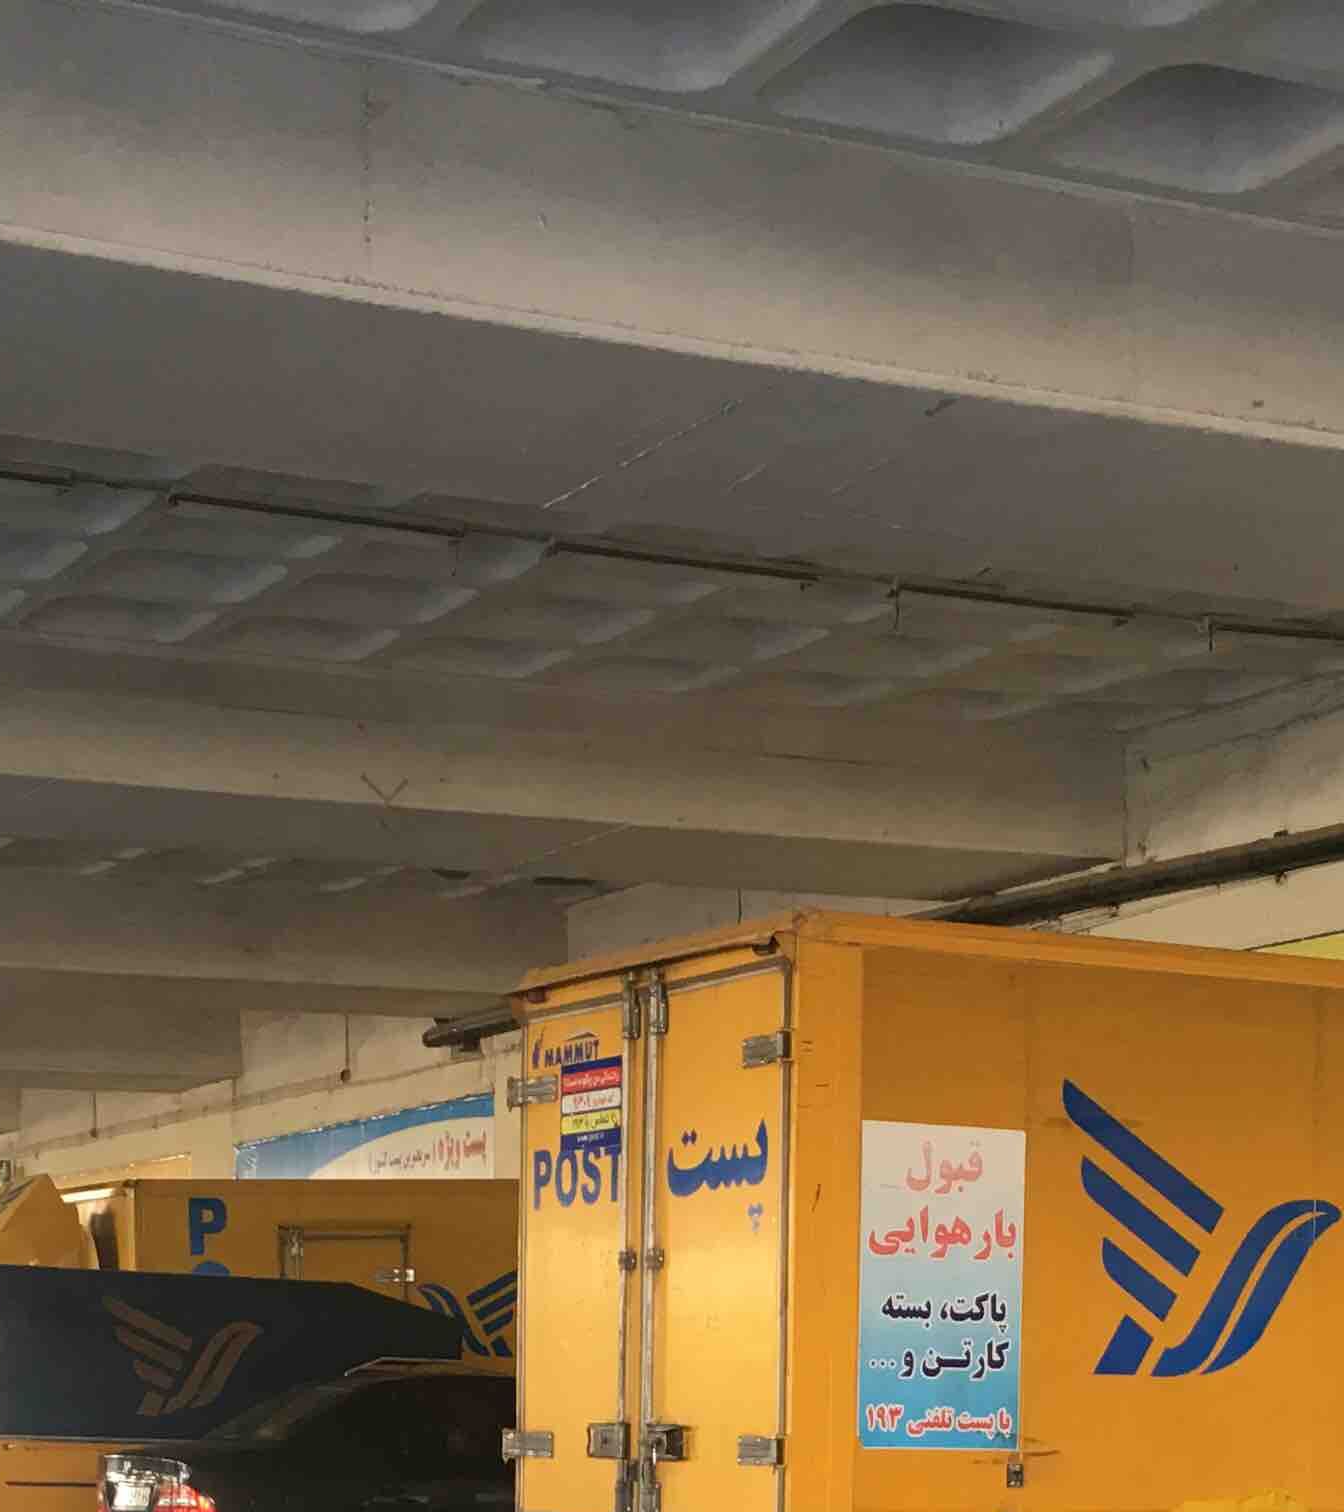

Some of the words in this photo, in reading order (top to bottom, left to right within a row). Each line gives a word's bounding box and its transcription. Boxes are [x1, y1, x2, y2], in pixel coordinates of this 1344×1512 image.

[543, 1039, 600, 1068] MAMMUT
[533, 1148, 622, 1211] POST
[666, 1118, 769, 1234] پست
[906, 1138, 984, 1195] قبول
[868, 1204, 972, 1259] هوایی
[973, 1207, 1017, 1260] بار
[881, 1294, 932, 1329] بسته
[866, 1402, 904, 1432] ۱۹۳
[906, 1406, 955, 1437] تلفنی
[957, 1410, 995, 1440] پست
